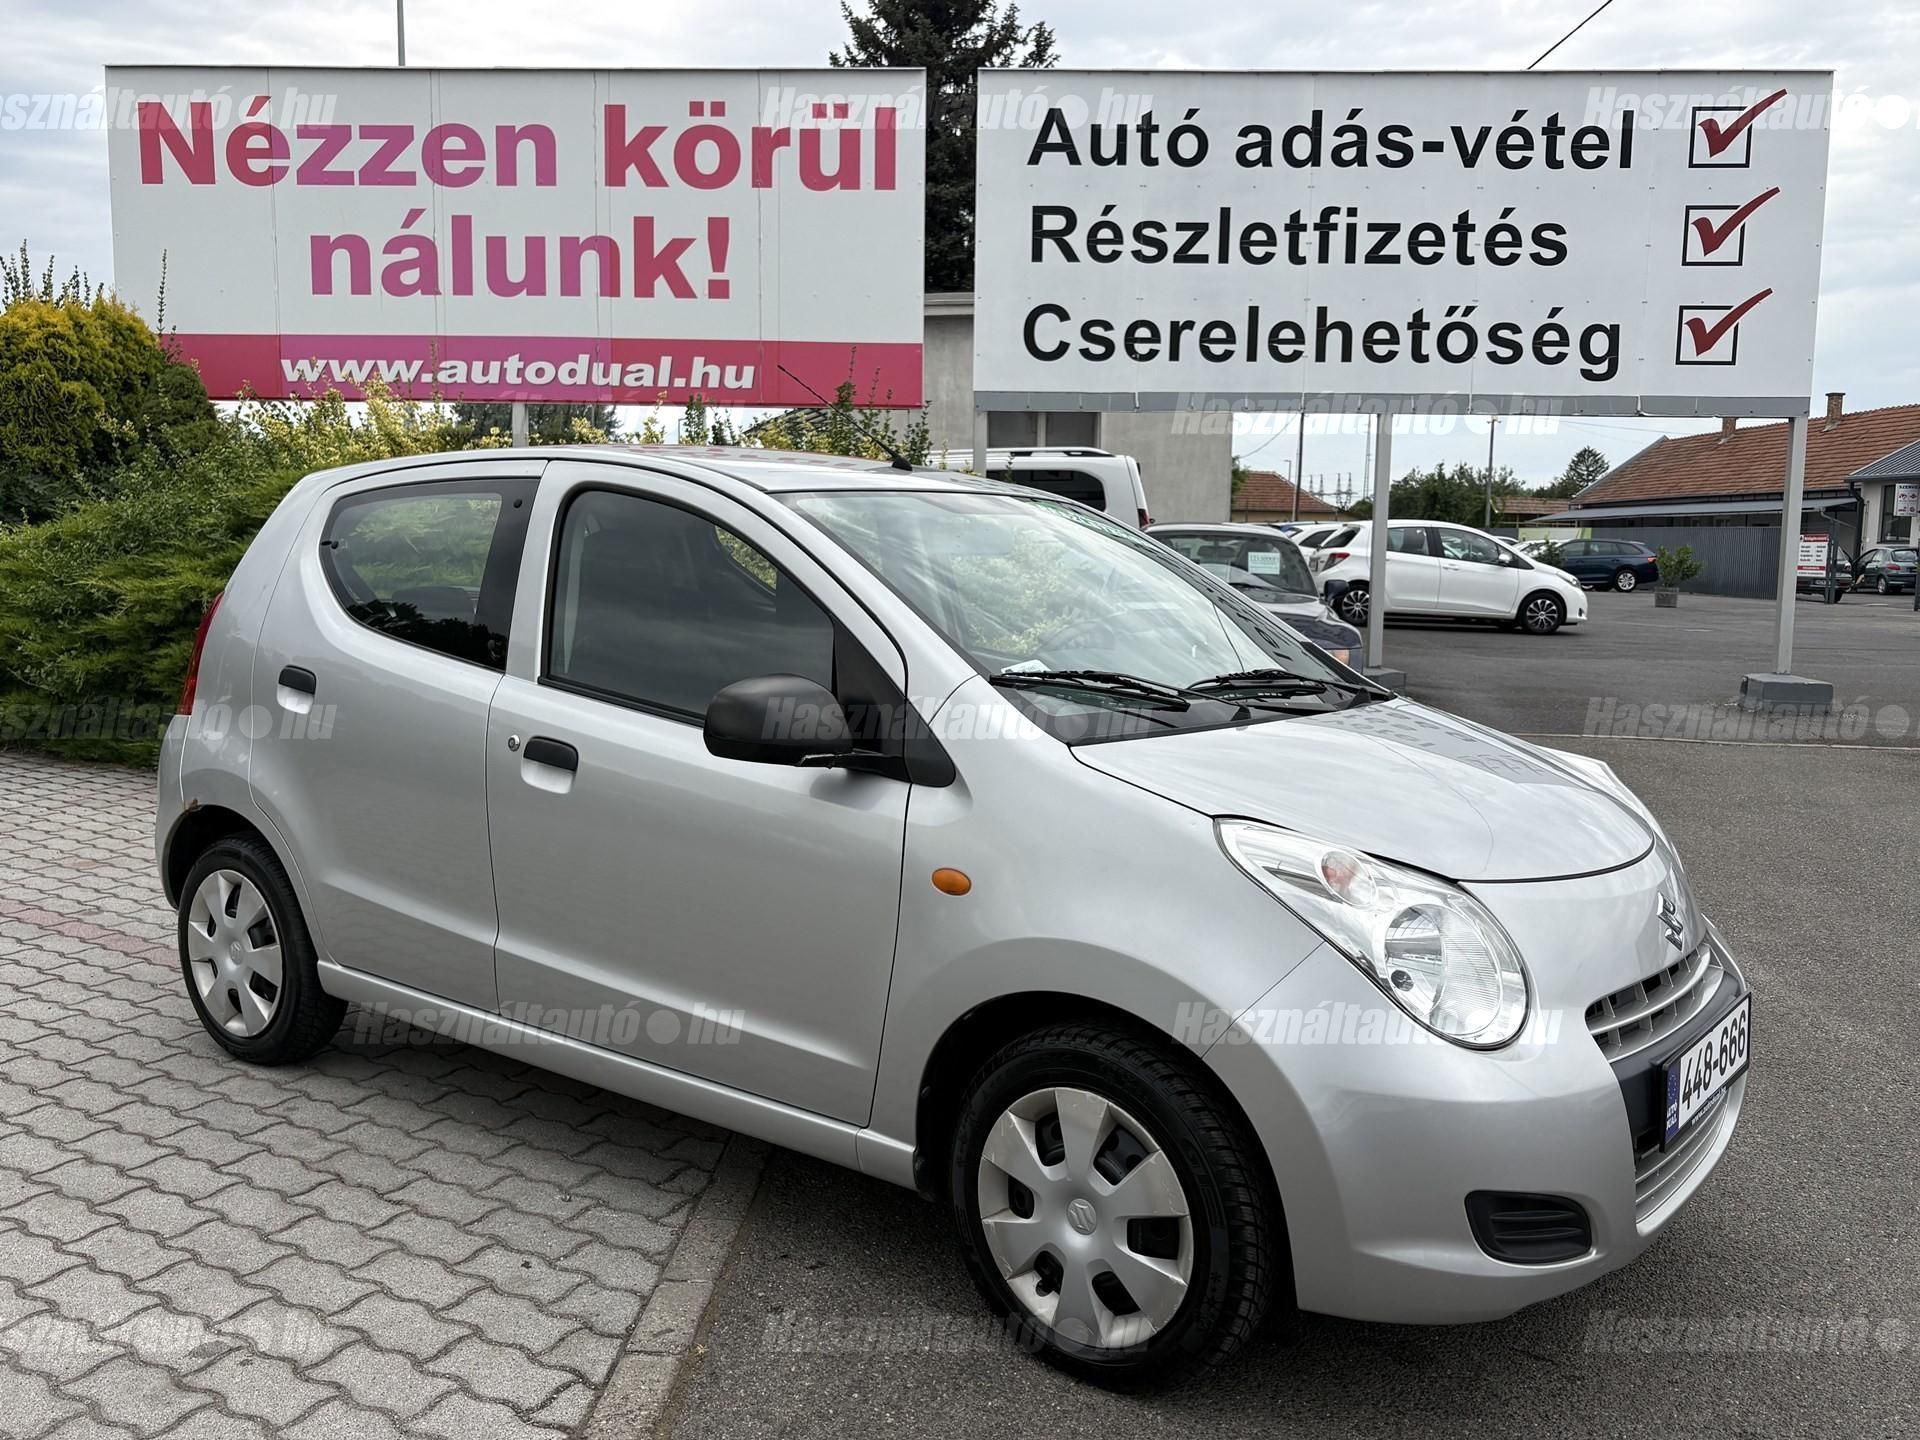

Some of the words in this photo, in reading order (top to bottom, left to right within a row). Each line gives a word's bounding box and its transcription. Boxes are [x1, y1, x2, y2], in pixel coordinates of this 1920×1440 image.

[138, 95, 557, 188] Nézzen
[604, 101, 897, 192] körül
[1027, 107, 1210, 168] Autó
[1235, 108, 1636, 170] adás-vétel
[310, 208, 731, 300] nálunk!
[1031, 204, 1569, 267] Részletfizetés
[281, 352, 756, 390] www.autodual.hu
[1023, 303, 1622, 382] Cserelehetőség
[1681, 1009, 1747, 1110] 448-666
